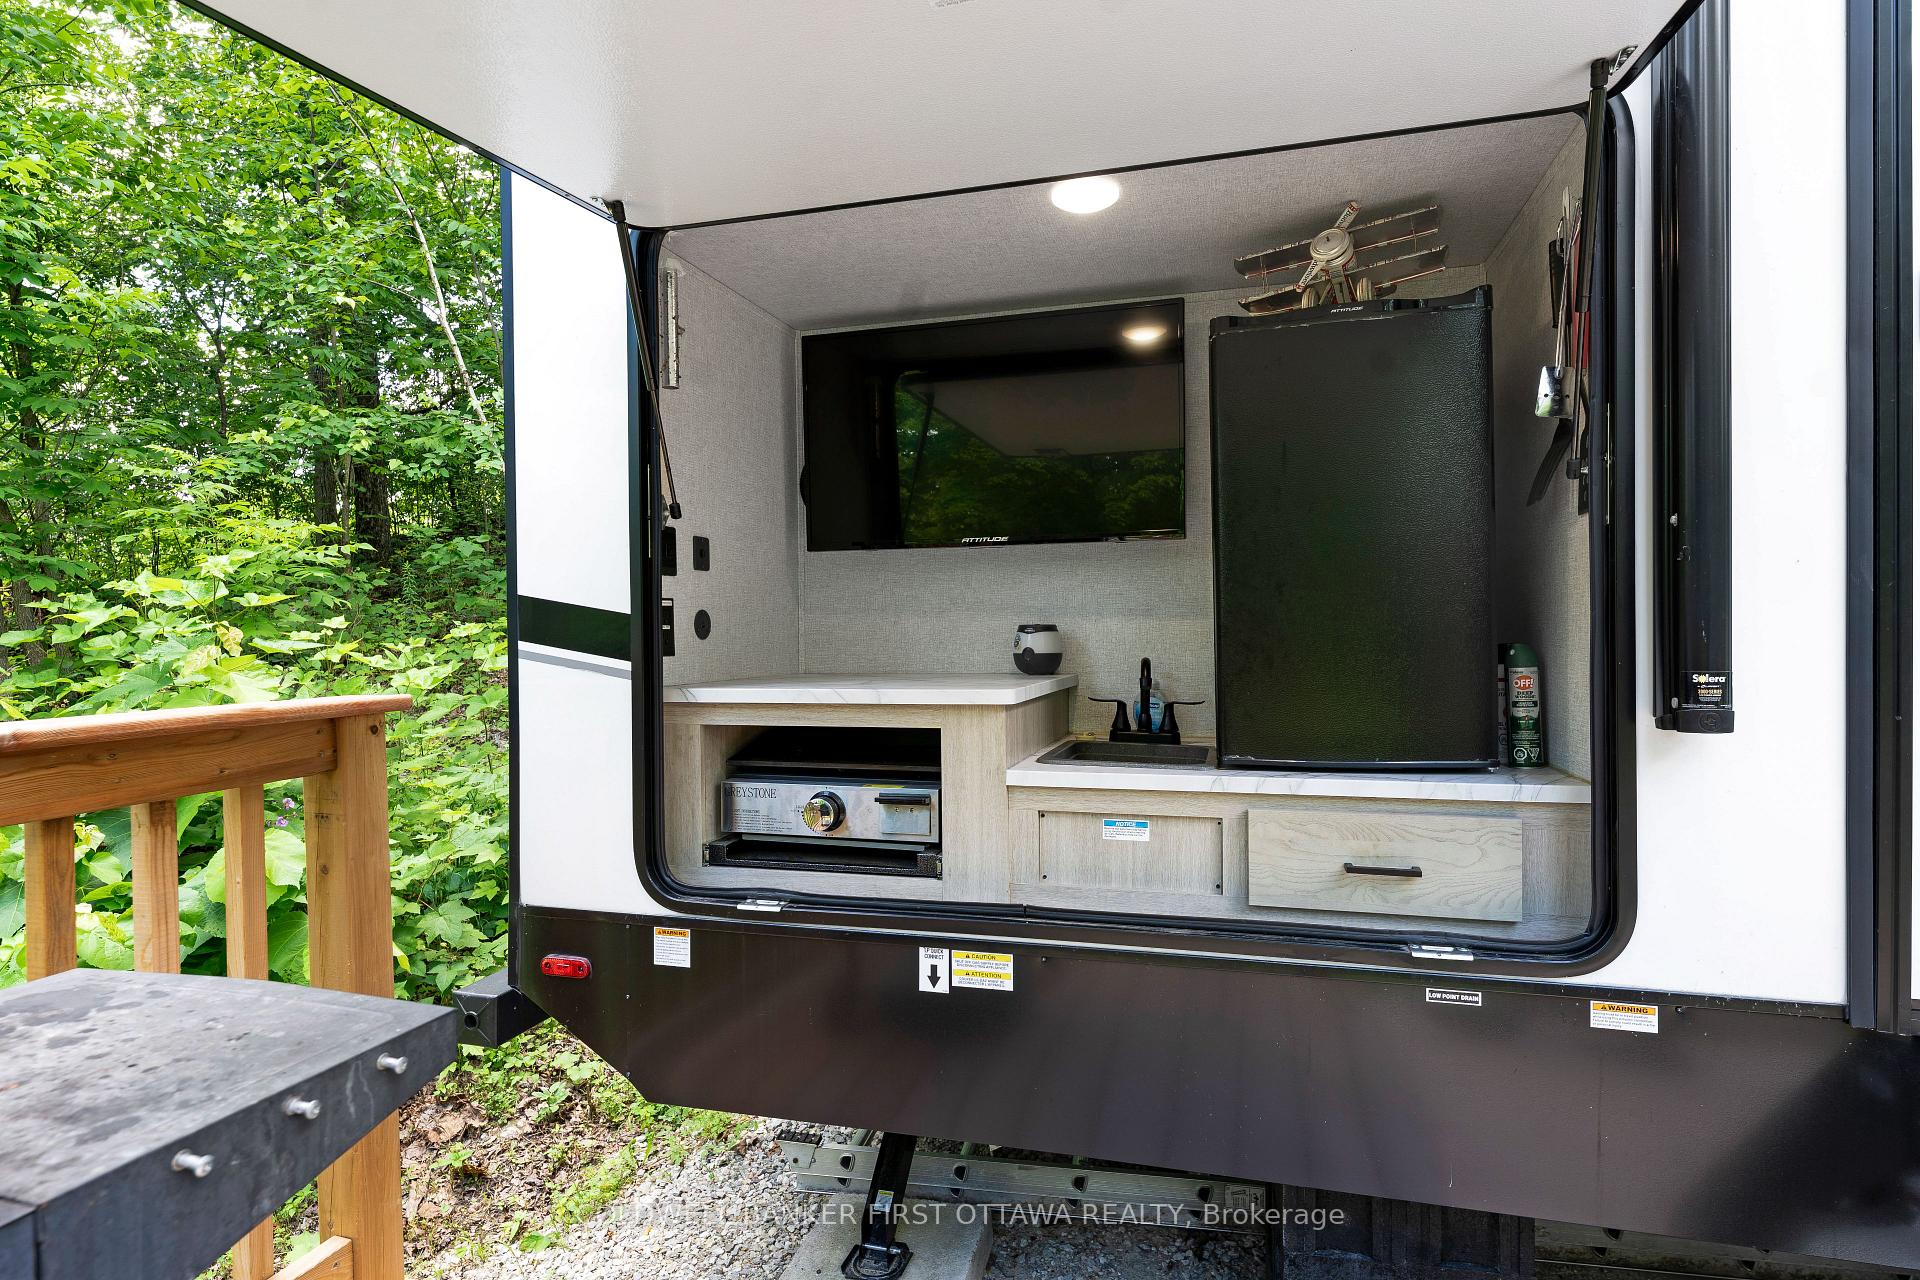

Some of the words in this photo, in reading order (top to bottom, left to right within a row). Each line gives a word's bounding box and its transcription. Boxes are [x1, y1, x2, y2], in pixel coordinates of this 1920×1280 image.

[1331, 305, 1363, 313] ATTITUDE
[1513, 678, 1534, 688] OFF!
[971, 953, 996, 961] CAUTION
[971, 970, 1002, 979] ATTENTION
[1608, 1004, 1648, 1014] WARNING
